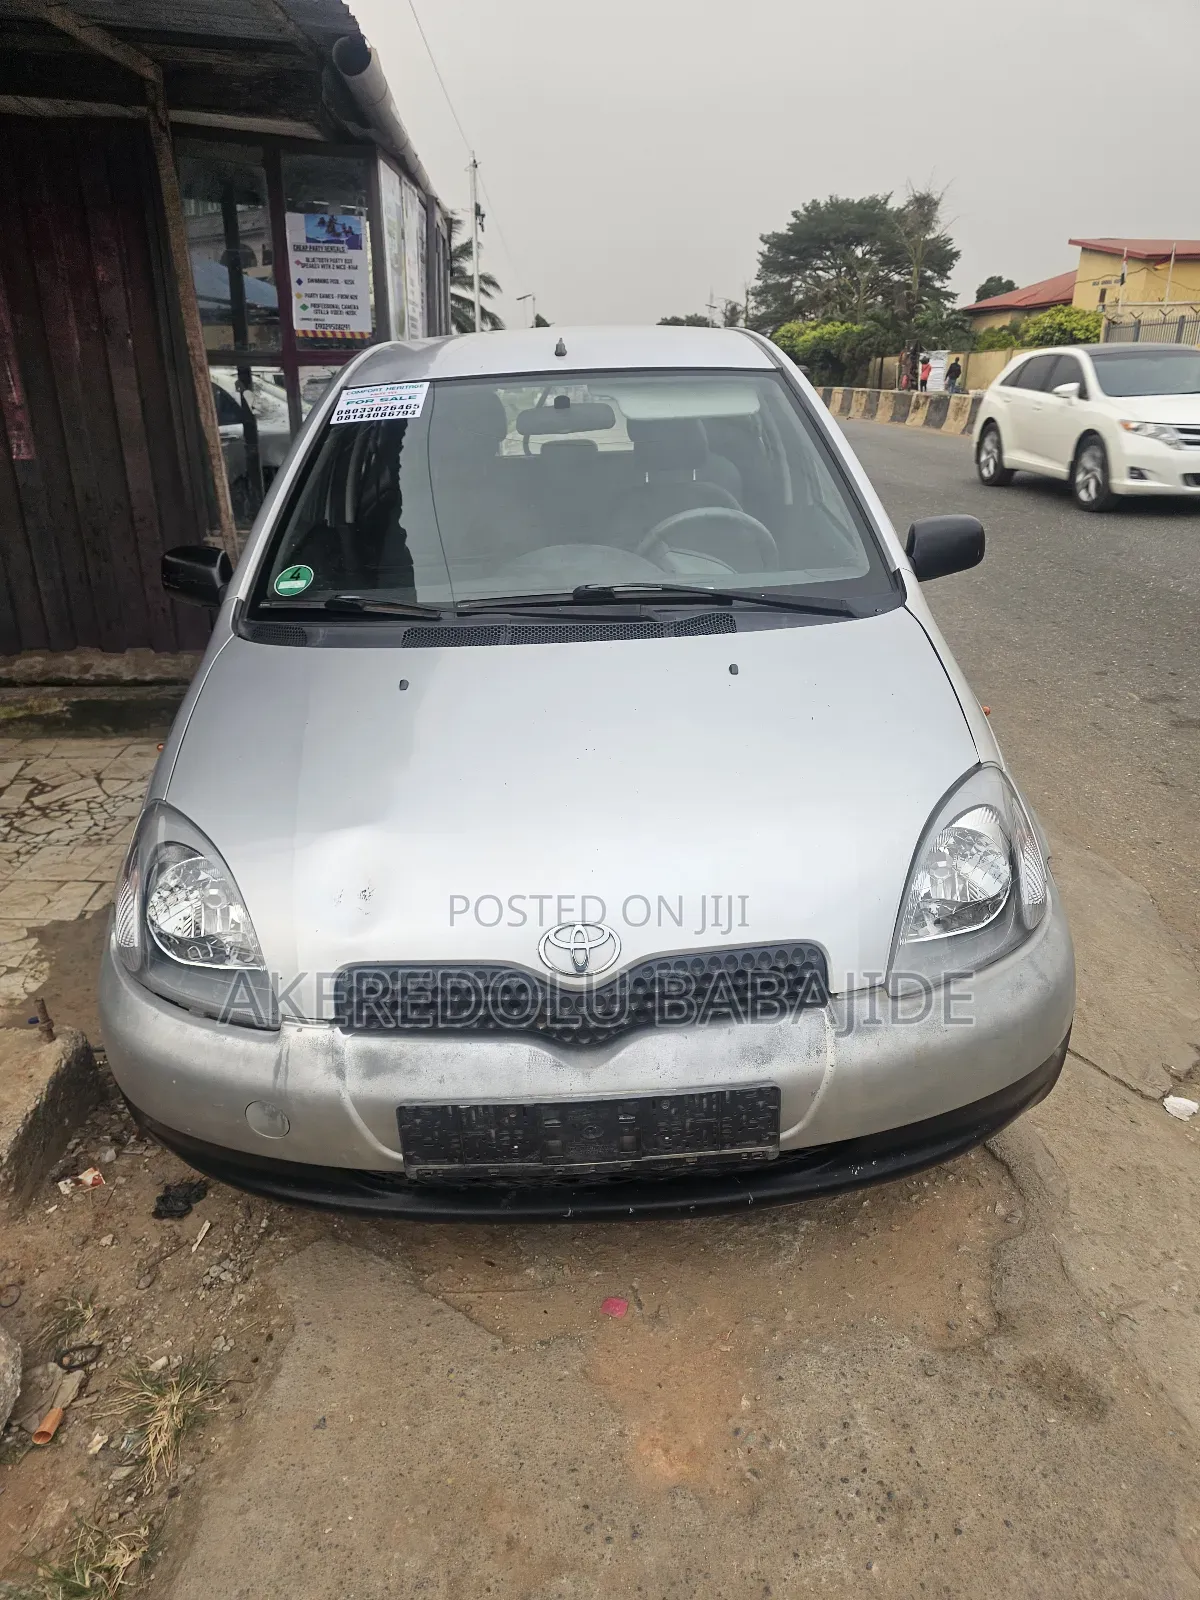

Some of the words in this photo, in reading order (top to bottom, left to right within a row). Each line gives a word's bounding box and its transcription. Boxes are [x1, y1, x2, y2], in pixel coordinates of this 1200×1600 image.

[292, 244, 309, 252] CHEAP
[346, 388, 383, 396] COMFORT
[337, 404, 420, 415] 08033026465
[337, 410, 416, 421] 08144086794
[290, 567, 301, 580] 4
